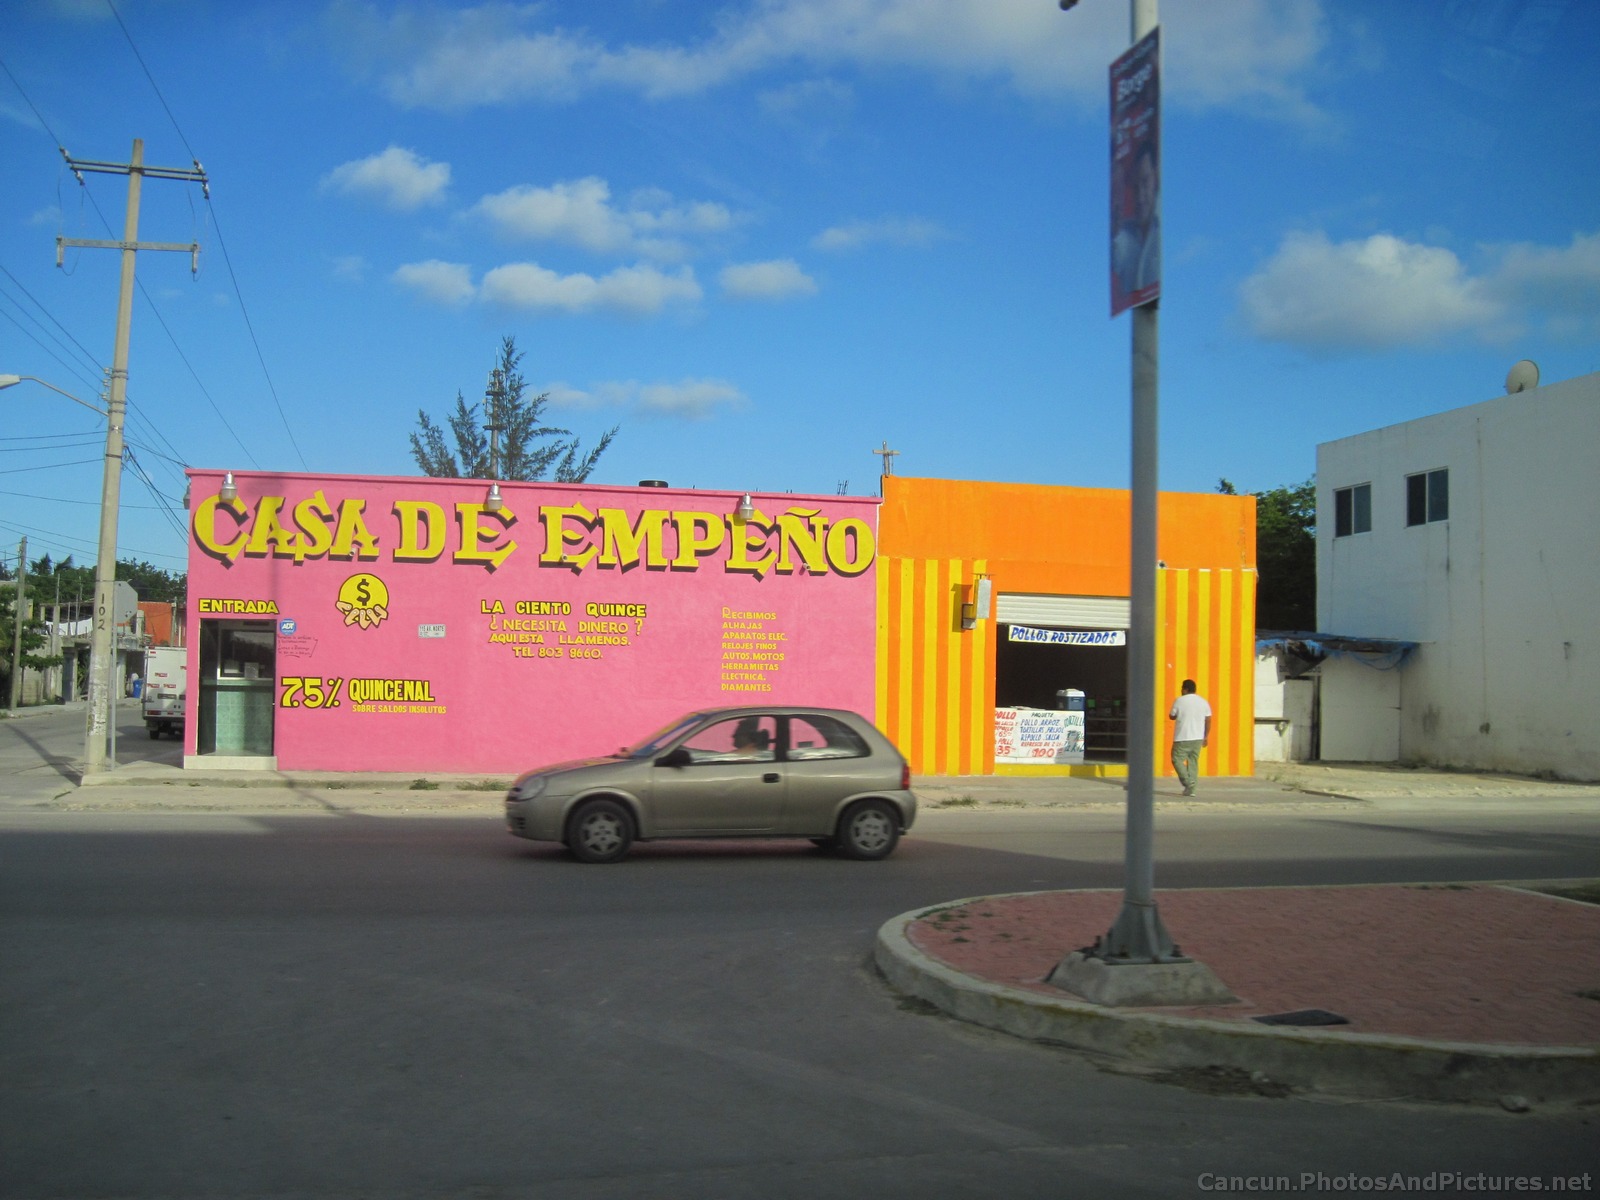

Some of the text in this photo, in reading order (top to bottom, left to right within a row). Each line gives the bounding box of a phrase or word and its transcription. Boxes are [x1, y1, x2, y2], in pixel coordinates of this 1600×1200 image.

[192, 489, 876, 579] CASA DE EMPEÑO
[199, 598, 280, 614] ENTRADA
[481, 600, 646, 617] LA CIENTO QUINCE
[722, 606, 777, 620] RECIBIMOS
[281, 622, 295, 630] ADT
[489, 633, 631, 646] AQUI ESTA LLAMENOS.
[722, 632, 788, 641] APARATOS ELEC.
[1011, 626, 1118, 645] POLLOS ROSTIZADOS
[513, 646, 534, 657] TEL
[538, 647, 564, 657] 803
[722, 642, 753, 650] RELOJES
[348, 678, 435, 704] QUINCENAL
[721, 683, 772, 692] DIAMANTES
[352, 705, 447, 714] SOBRE SALDOS INSOLUTOS
